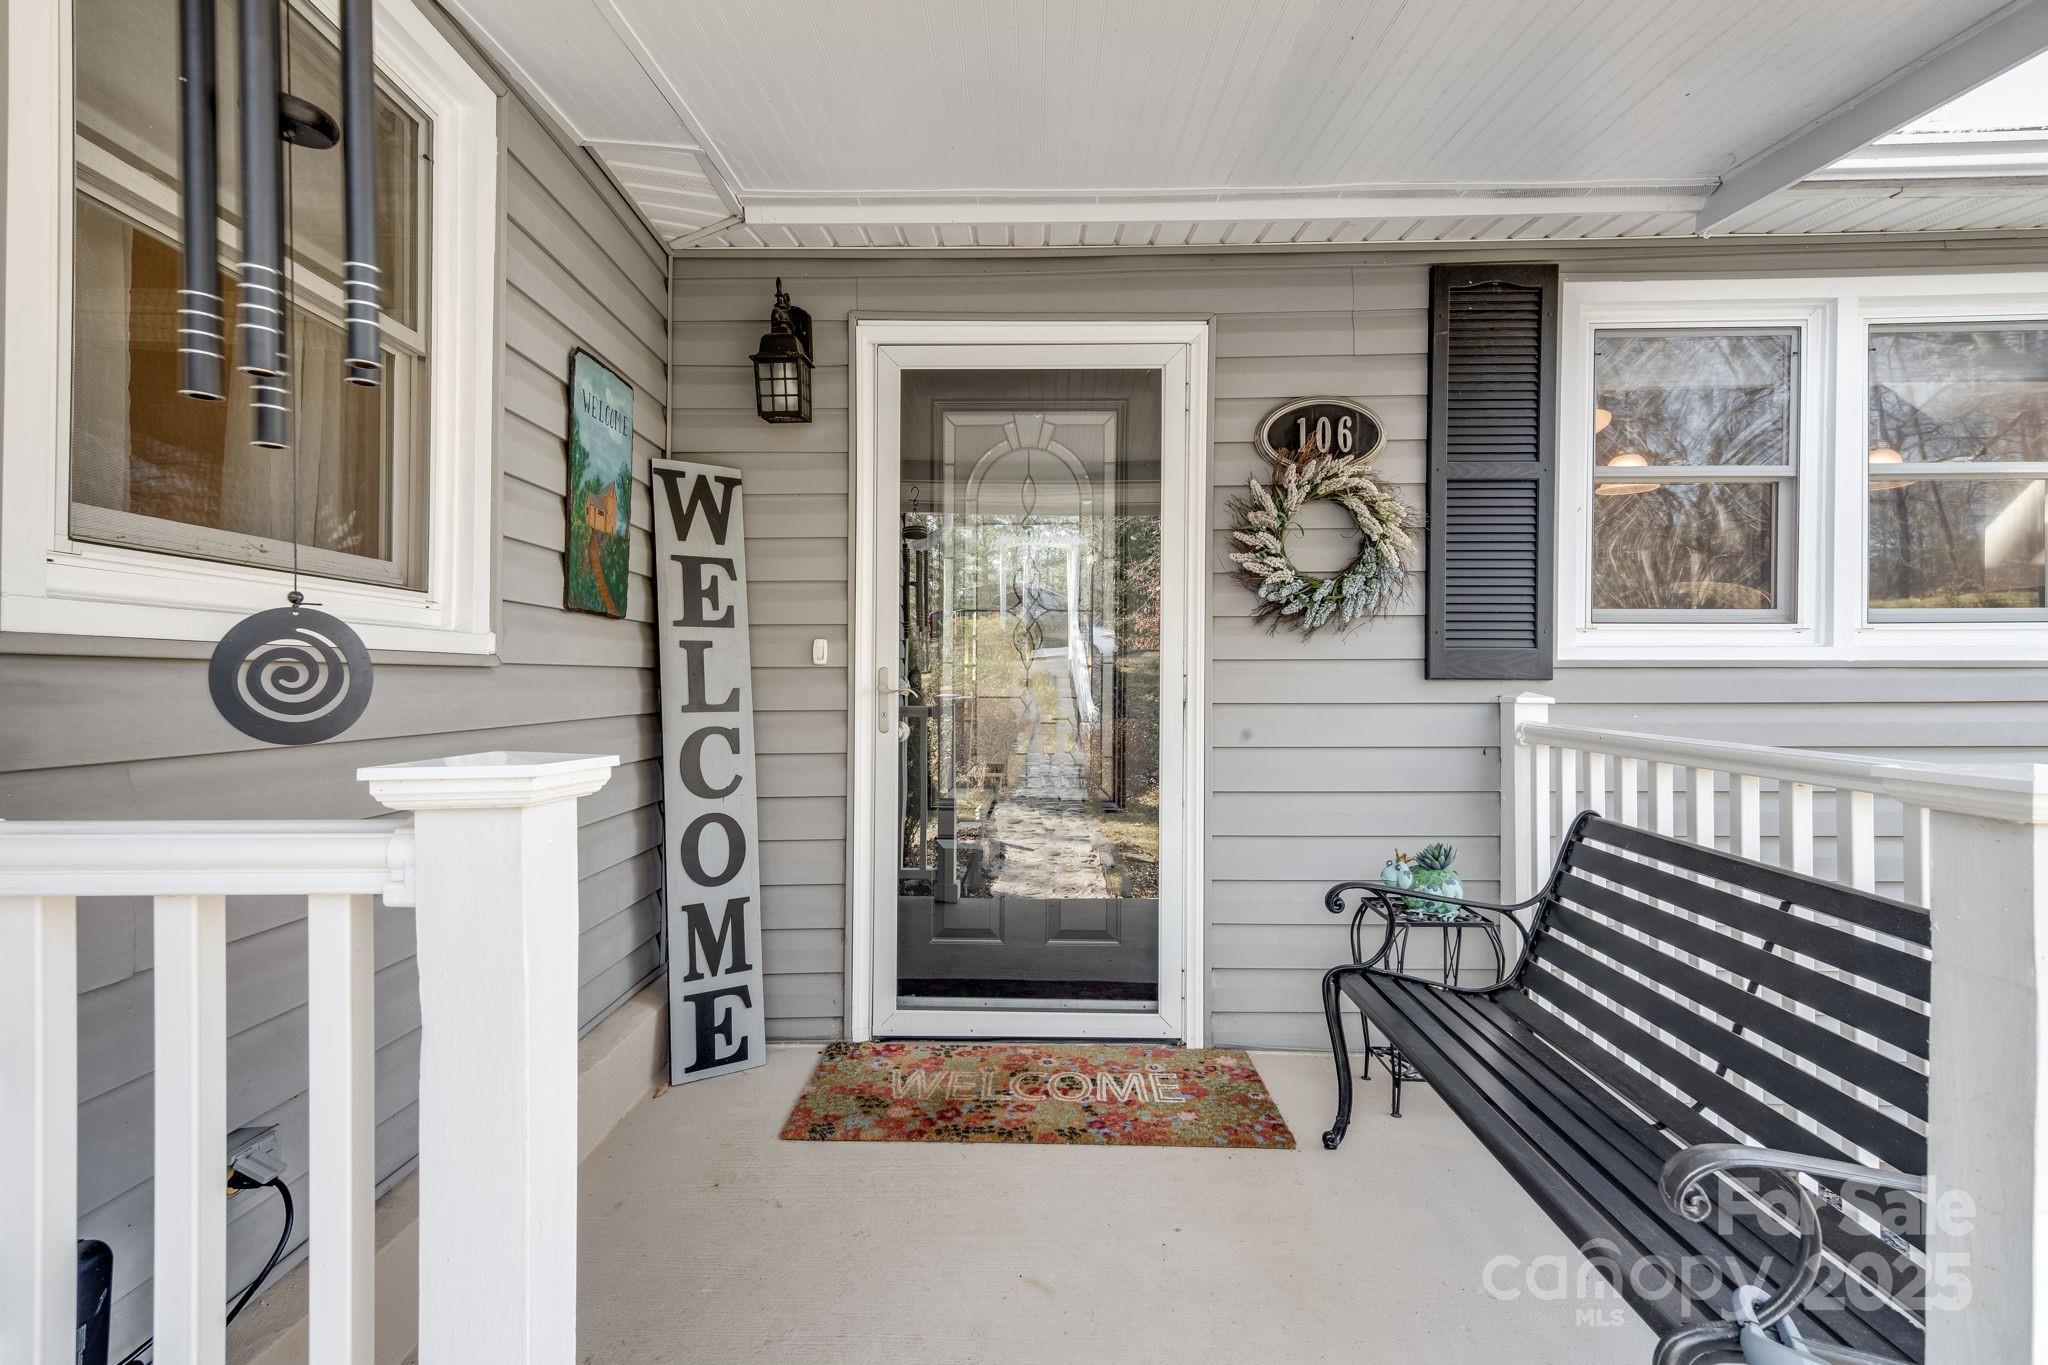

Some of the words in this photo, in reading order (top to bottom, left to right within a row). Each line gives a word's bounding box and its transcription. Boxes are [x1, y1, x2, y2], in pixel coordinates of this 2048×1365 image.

[581, 388, 628, 437] WELCOME
[1296, 415, 1353, 453] 106
[653, 467, 753, 1074] WELCOME
[890, 1068, 1186, 1104] WELCOME
